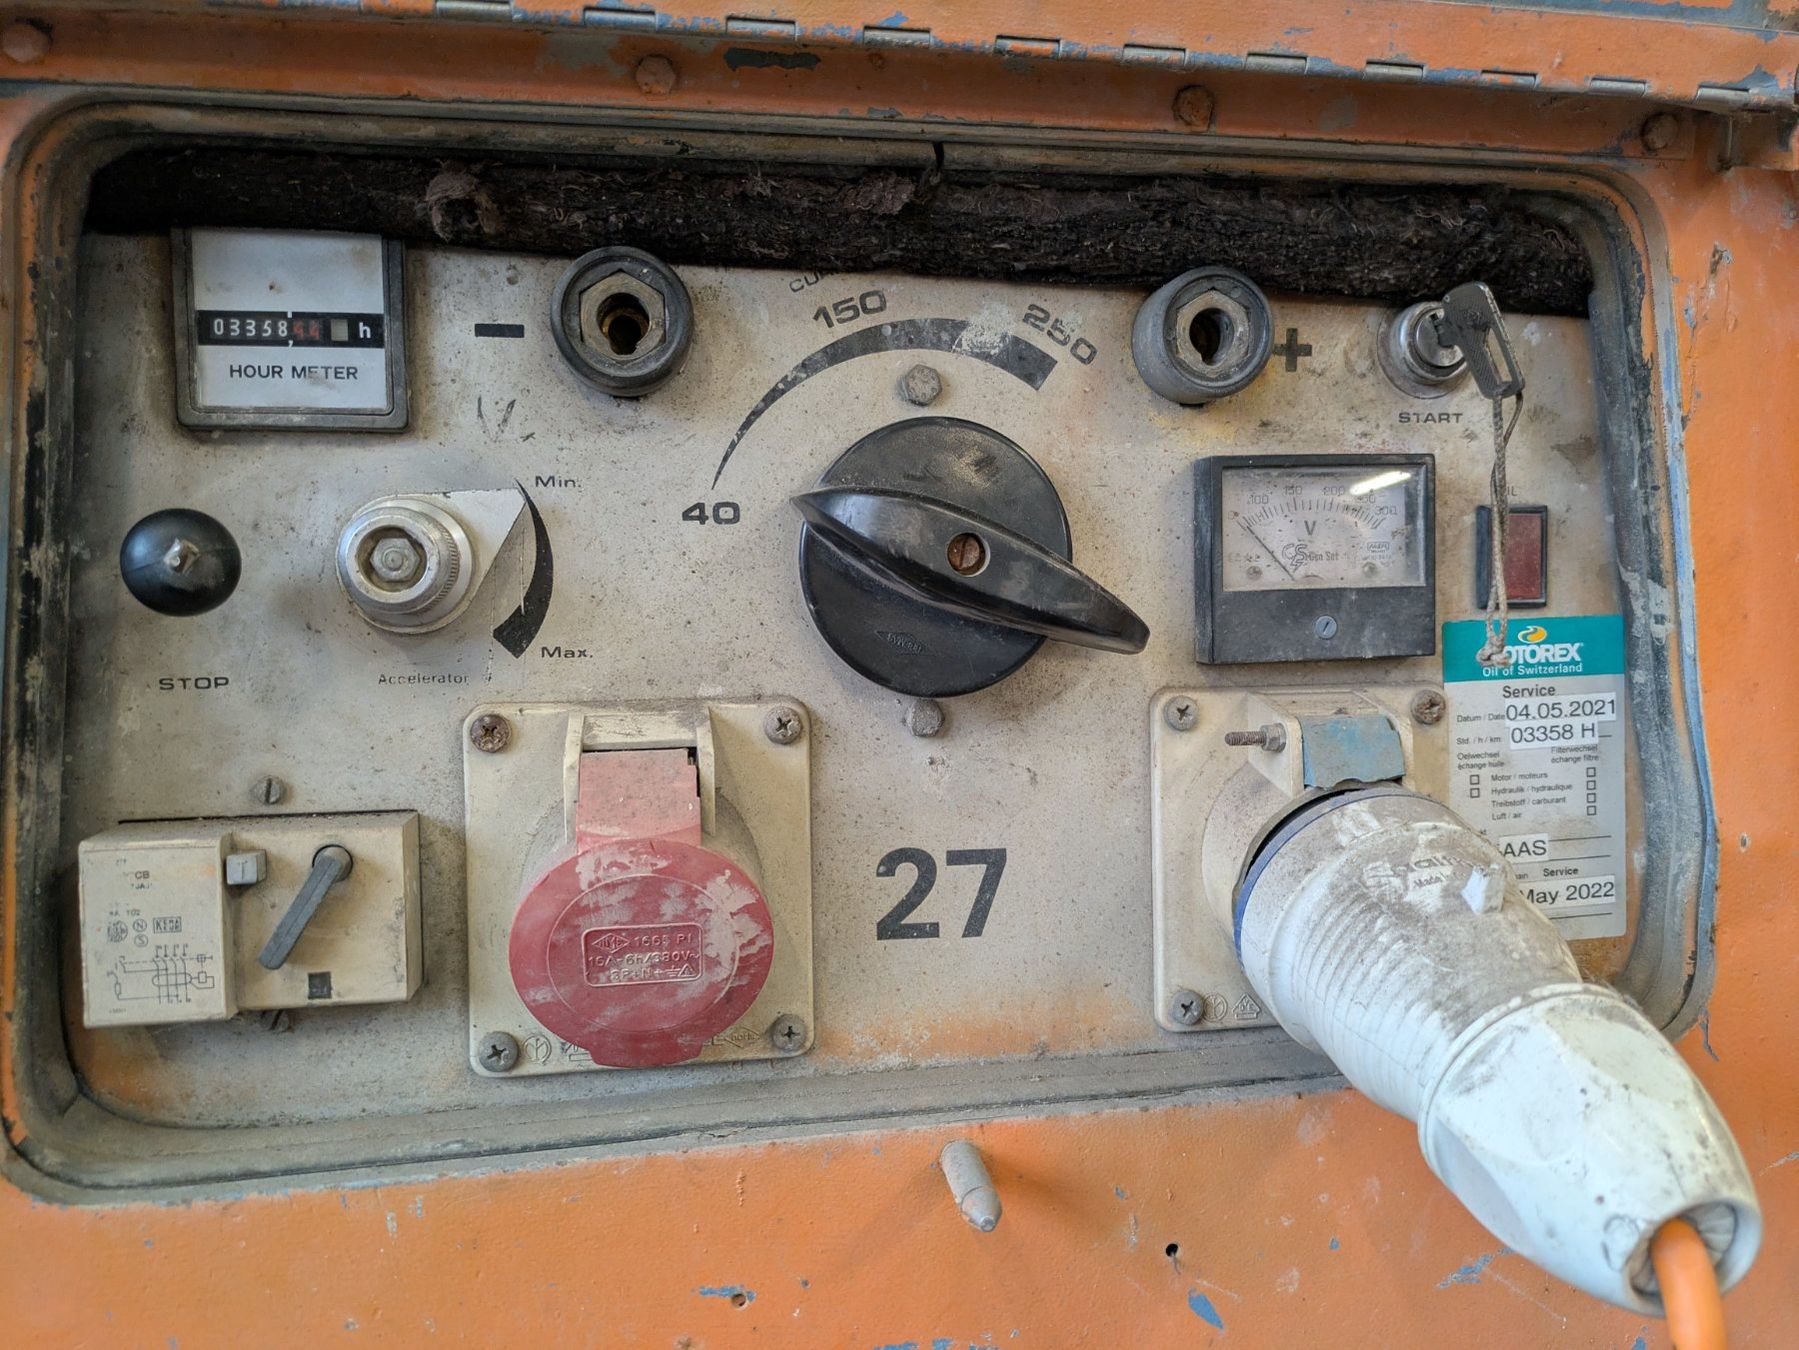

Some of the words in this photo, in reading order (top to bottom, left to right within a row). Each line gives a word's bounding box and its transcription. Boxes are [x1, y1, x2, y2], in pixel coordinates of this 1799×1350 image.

[812, 290, 887, 329] 150
[358, 322, 372, 339] h
[1022, 303, 1097, 365] 250
[229, 364, 283, 379] HOUR
[291, 365, 358, 380] METER
[1398, 412, 1463, 424] START
[535, 475, 582, 488] Min.
[682, 501, 740, 525] 40
[1304, 520, 1317, 536] V
[540, 646, 593, 659] Max.
[1500, 642, 1583, 665] OTOREX
[1482, 666, 1499, 678] Oil
[1502, 665, 1514, 677] of
[1517, 662, 1583, 676] Switzerland
[158, 676, 230, 691] STOP
[378, 673, 469, 686] Accelerator
[1502, 685, 1556, 699] Service
[1456, 714, 1482, 724] Datum
[1505, 699, 1616, 722] 04.05.2021
[1511, 724, 1574, 744] 03358
[1581, 722, 1596, 739] H
[1456, 751, 1500, 762] Oelwechsel
[1490, 773, 1513, 783] Motor
[1517, 771, 1549, 781] moteurs
[1490, 786, 1525, 797] Hydraulik
[1531, 783, 1573, 795] hydraulique
[1491, 800, 1526, 809] Treibstoff
[1531, 796, 1566, 806] carburant
[1491, 812, 1506, 822] Luft
[1512, 811, 1523, 820] air
[1498, 839, 1547, 858] AAS
[1543, 866, 1580, 878] Service
[876, 846, 1007, 941] 27
[1565, 880, 1615, 901] 2022
